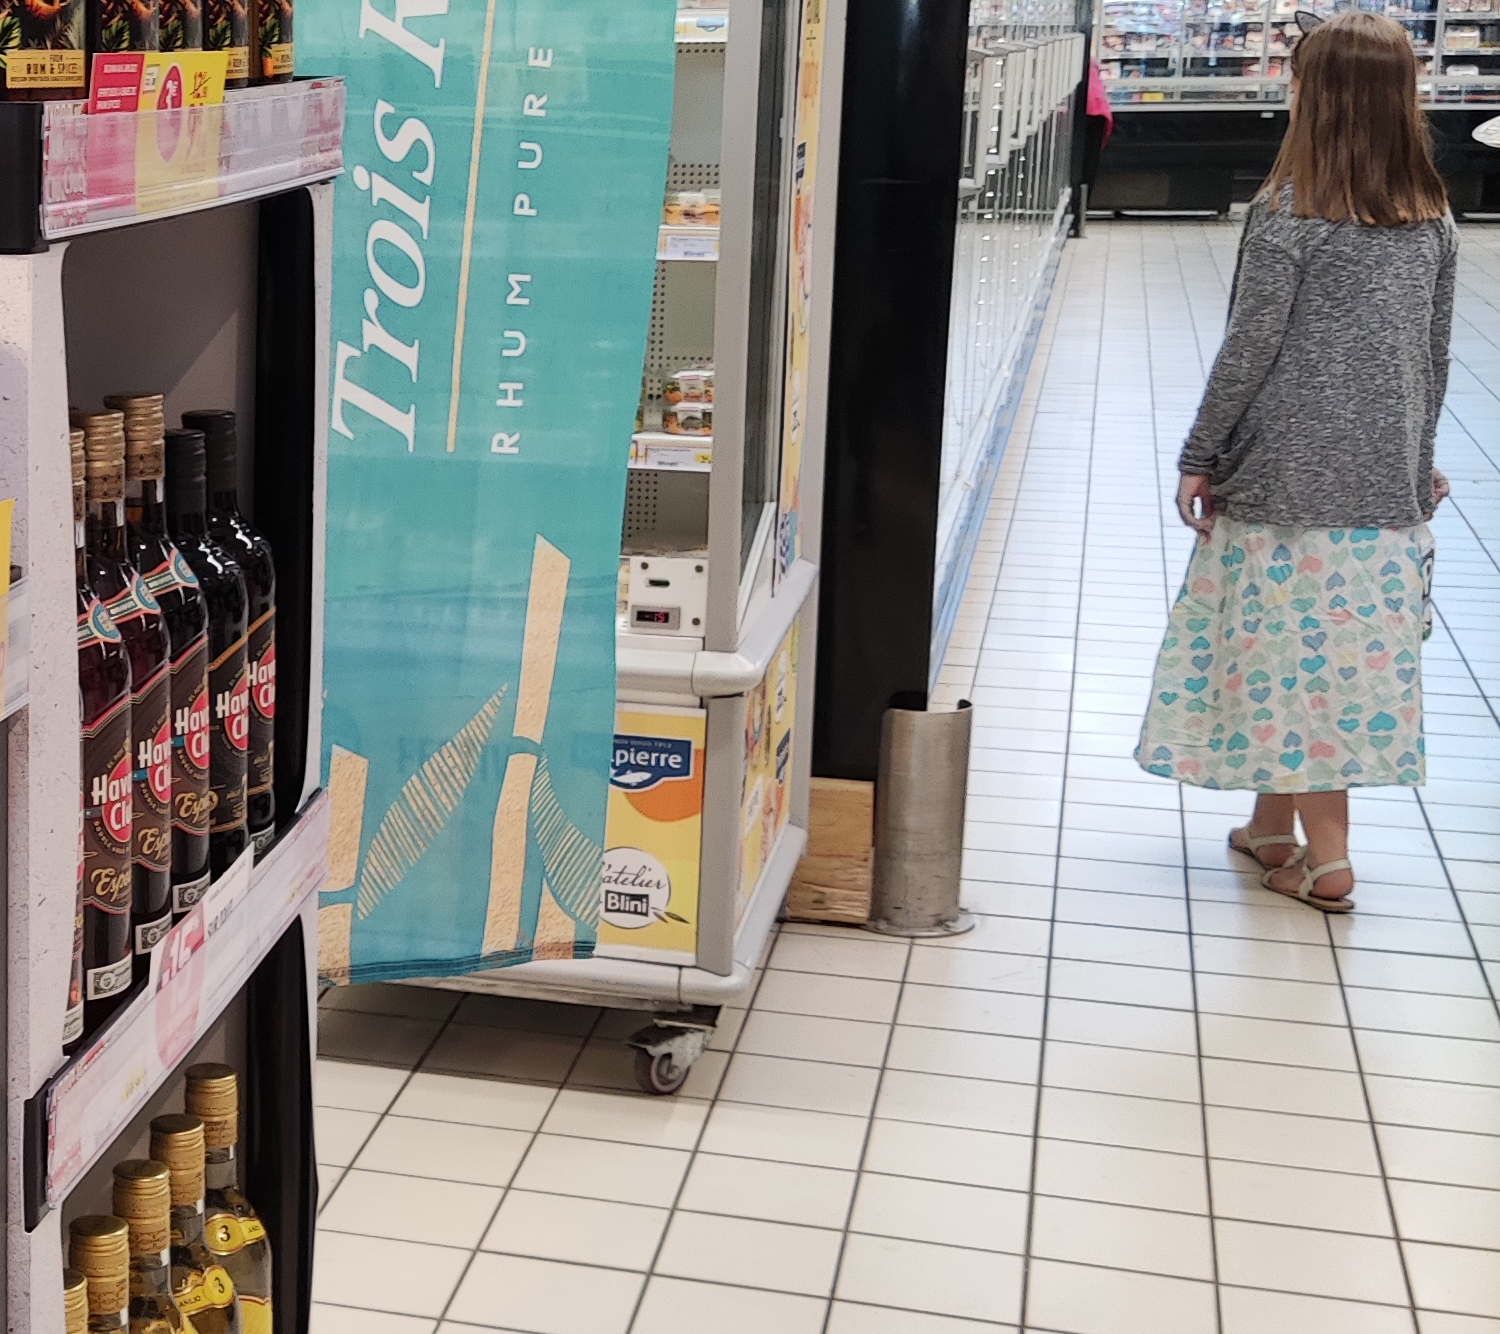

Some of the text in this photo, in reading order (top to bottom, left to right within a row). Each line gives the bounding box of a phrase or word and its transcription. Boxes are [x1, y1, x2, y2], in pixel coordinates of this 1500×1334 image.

[491, 273, 532, 456] RHUM
[514, 45, 553, 219] PURE
[331, 99, 437, 454] Trois
[612, 746, 683, 769] pierre
[602, 861, 667, 890] 'atelier
[606, 893, 648, 914] Blini
[218, 1224, 231, 1243] 3
[214, 1276, 226, 1294] 3
